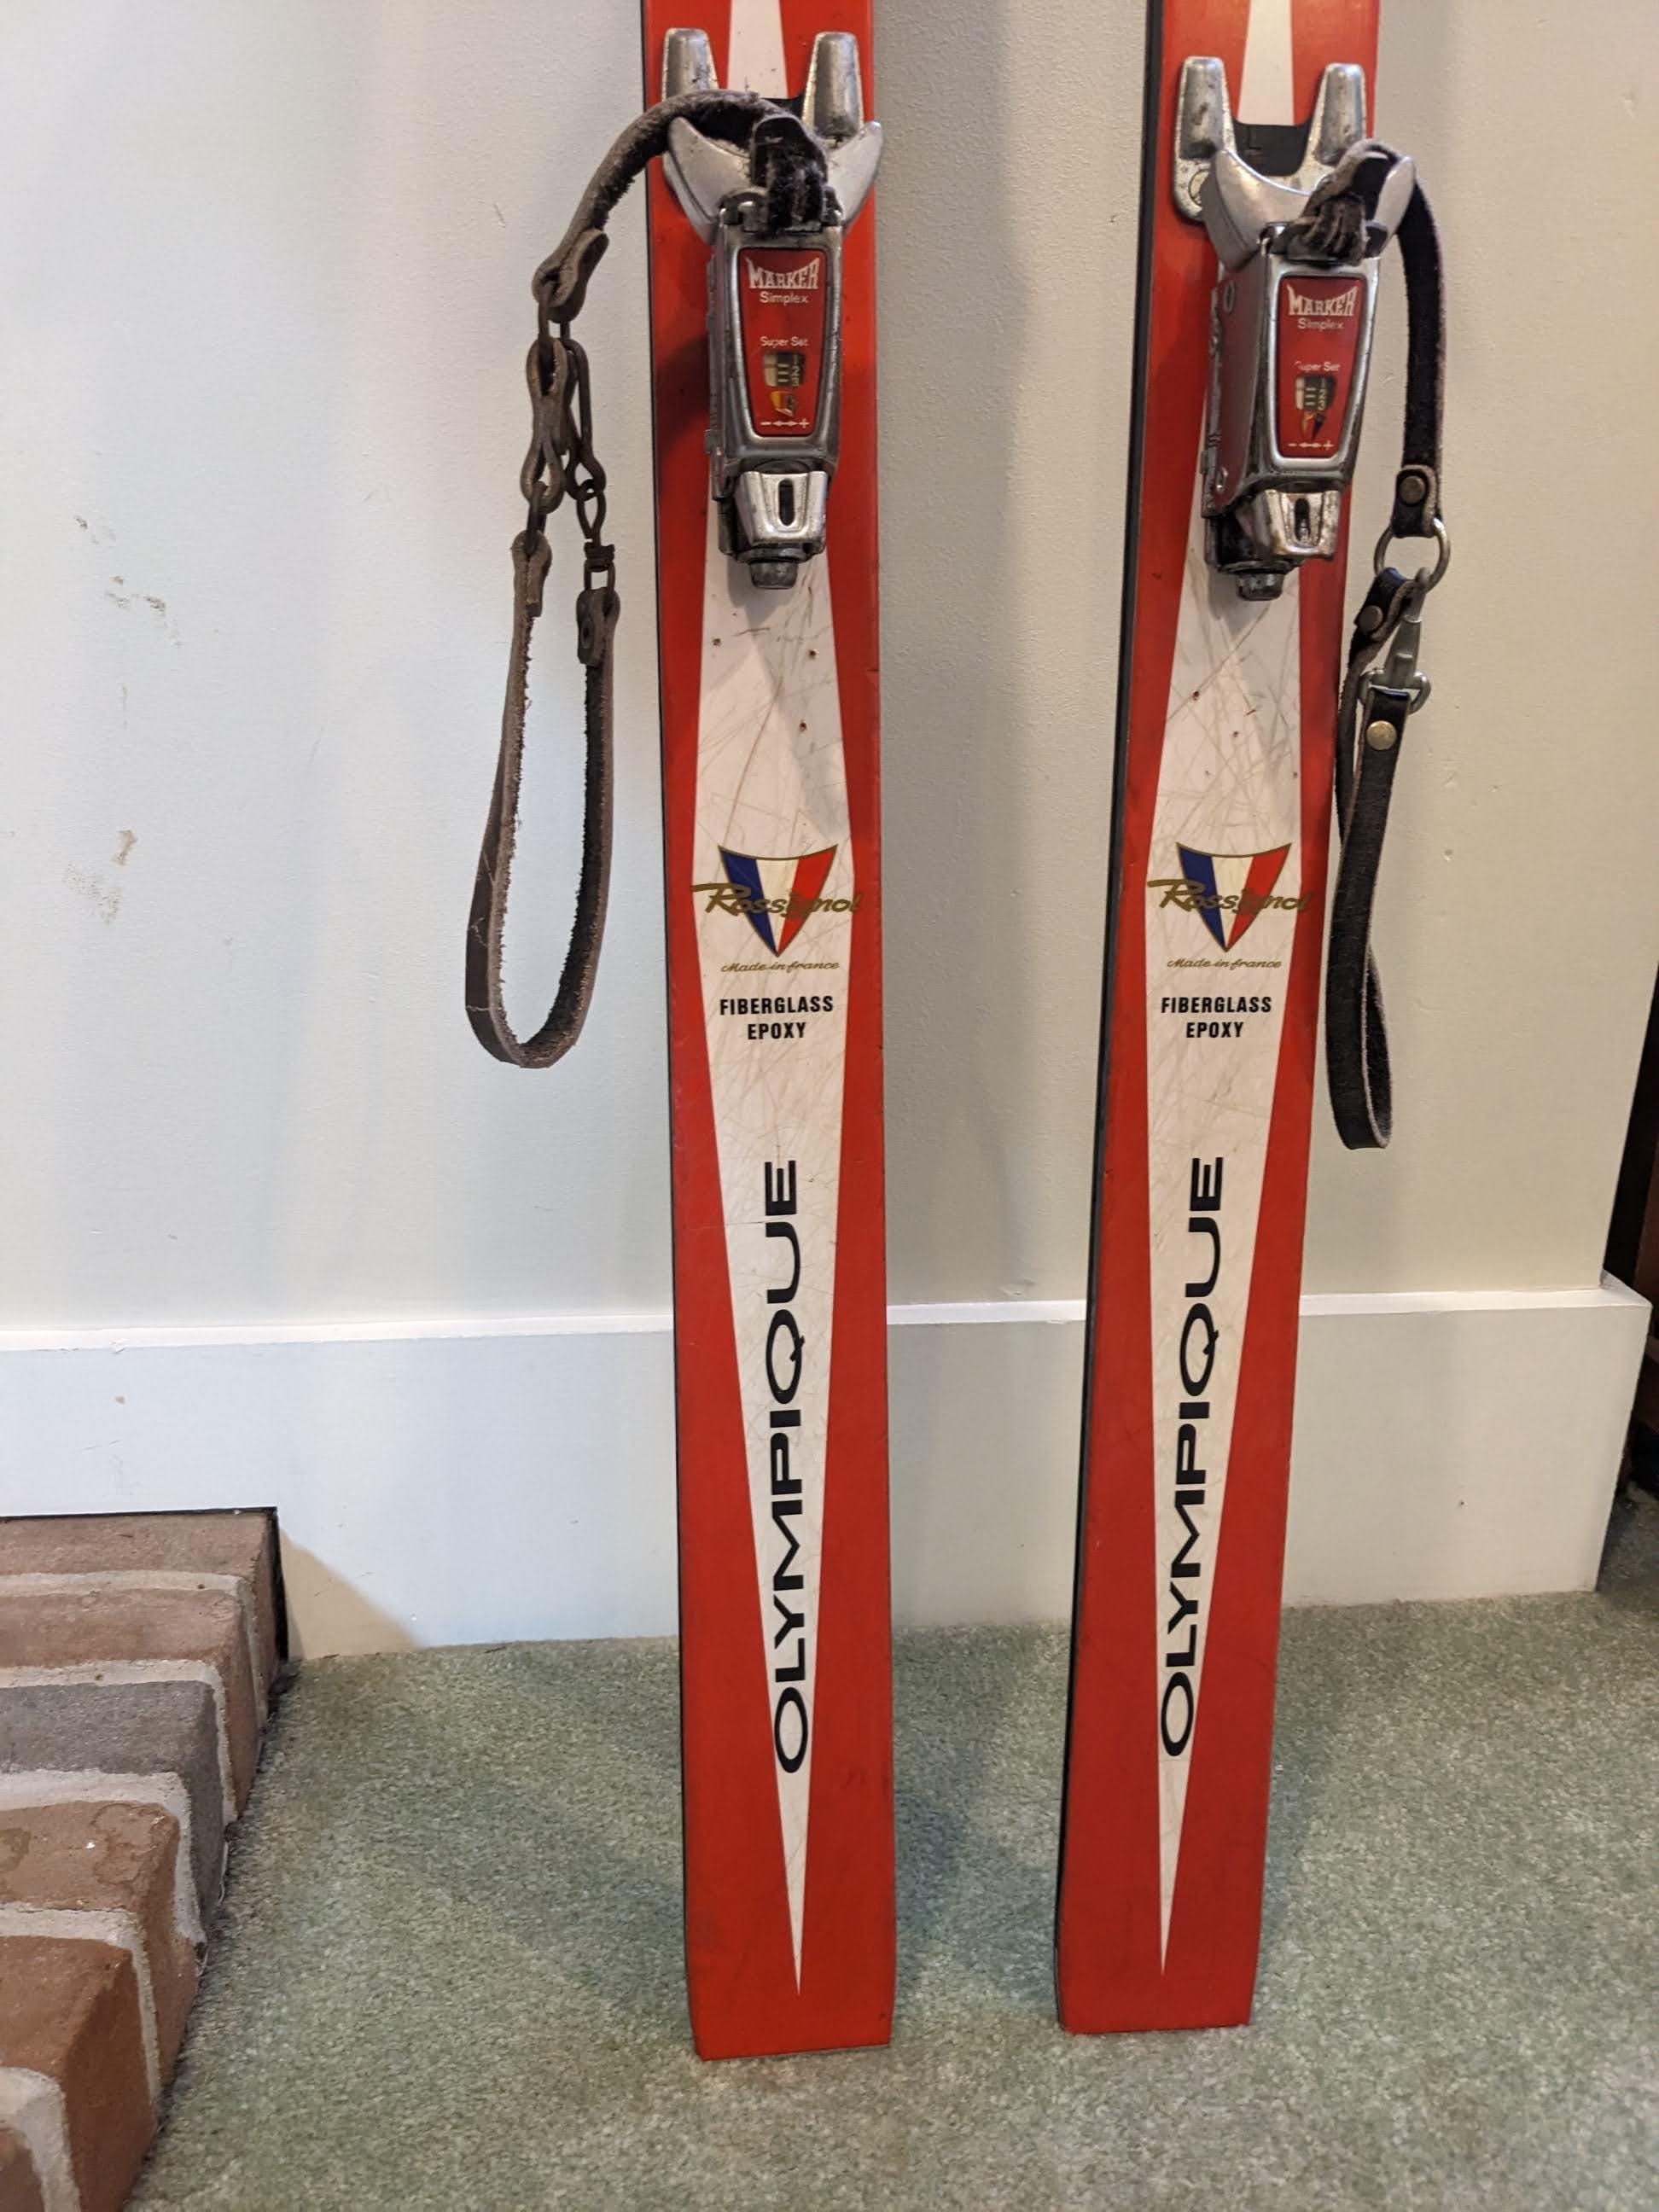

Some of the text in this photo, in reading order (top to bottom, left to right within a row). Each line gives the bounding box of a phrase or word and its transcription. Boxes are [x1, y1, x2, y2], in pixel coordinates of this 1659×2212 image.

[745, 257, 820, 289] MARKER
[760, 292, 809, 305] Simplex
[1287, 285, 1358, 316] MARKER
[1297, 317, 1344, 329] Simplex
[760, 336, 789, 347] Super
[690, 882, 862, 919] Rossnol
[1147, 879, 1313, 915] Rossnol
[721, 962, 766, 973] Made
[1167, 959, 1211, 968] Made
[719, 996, 834, 1016] FIBERGLASS
[1161, 996, 1272, 1013] FIBERGLASS
[748, 1022, 807, 1039] EPOXY
[1186, 1022, 1244, 1038] EPOXY
[1161, 1156, 1224, 1757] OLYMPIQUE
[765, 1159, 808, 1773] OLYMPIQUE
